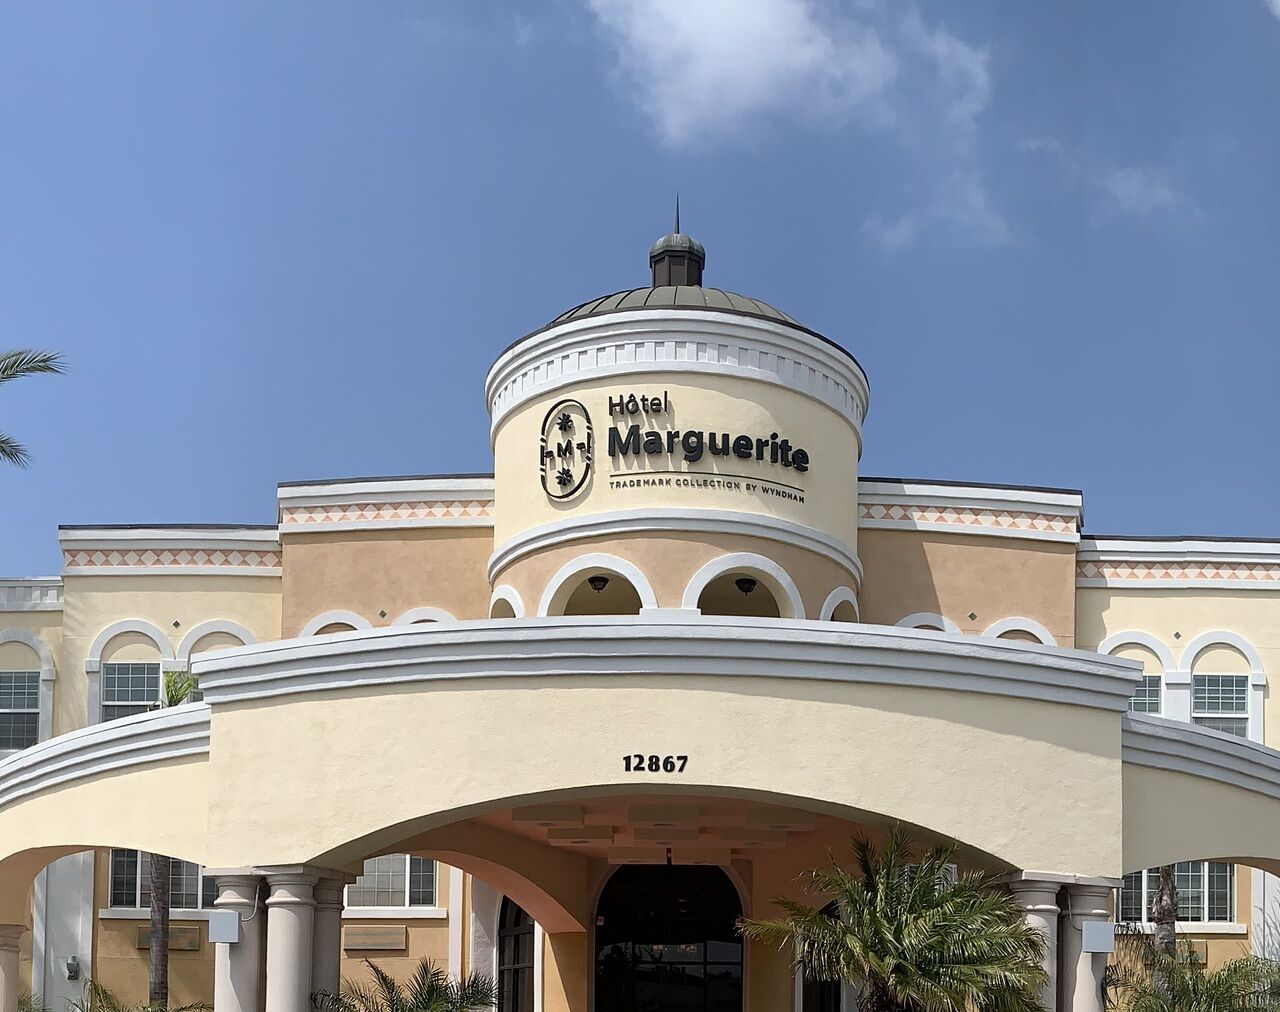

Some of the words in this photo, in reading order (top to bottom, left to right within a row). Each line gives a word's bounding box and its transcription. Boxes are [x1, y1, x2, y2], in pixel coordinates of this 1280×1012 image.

[607, 390, 669, 417] Hôtel
[607, 424, 810, 473] Marguerite
[609, 478, 672, 489] TRADEMARK
[675, 478, 740, 490] COLLECTION
[745, 483, 757, 492] BY
[761, 487, 805, 503] WYNDHAM
[622, 753, 689, 773] 12867
